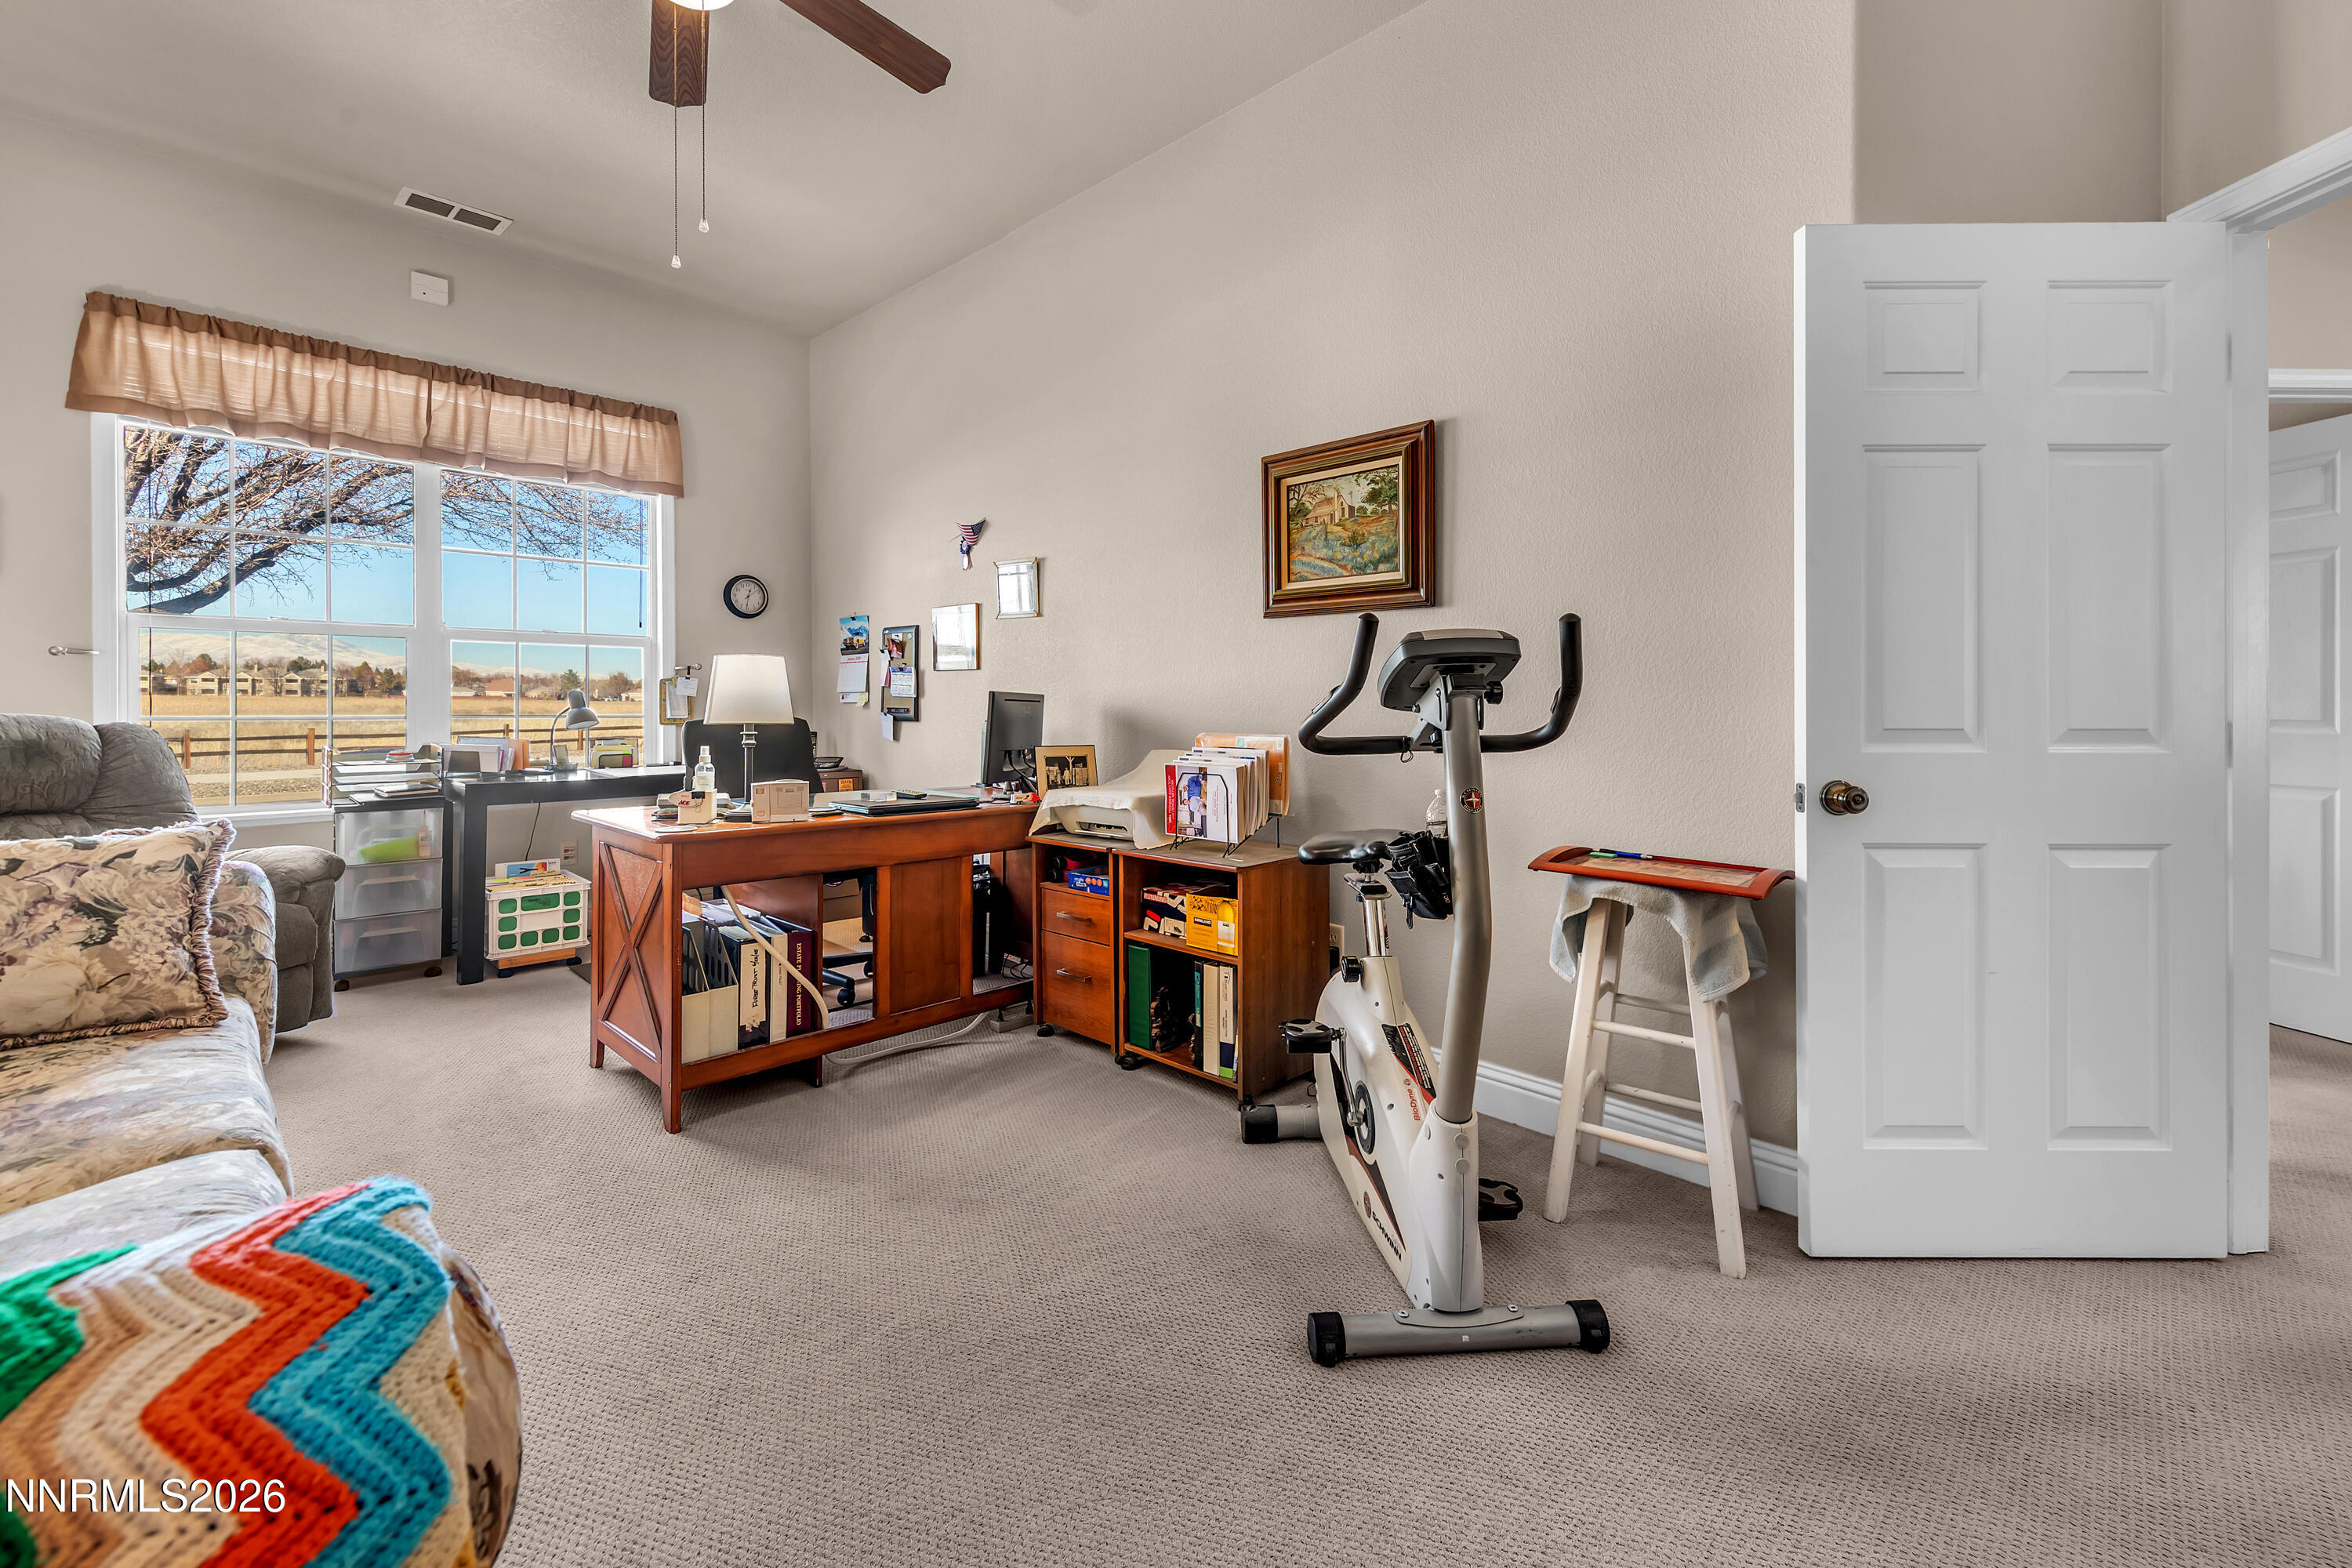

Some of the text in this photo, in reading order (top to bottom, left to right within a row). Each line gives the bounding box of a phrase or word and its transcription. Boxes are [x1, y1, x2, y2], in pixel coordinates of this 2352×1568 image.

[1143, 892, 1167, 903] RUNNING
[1407, 1088, 1421, 1122] BioDyne
[1372, 1210, 1402, 1261] SCHWINN
